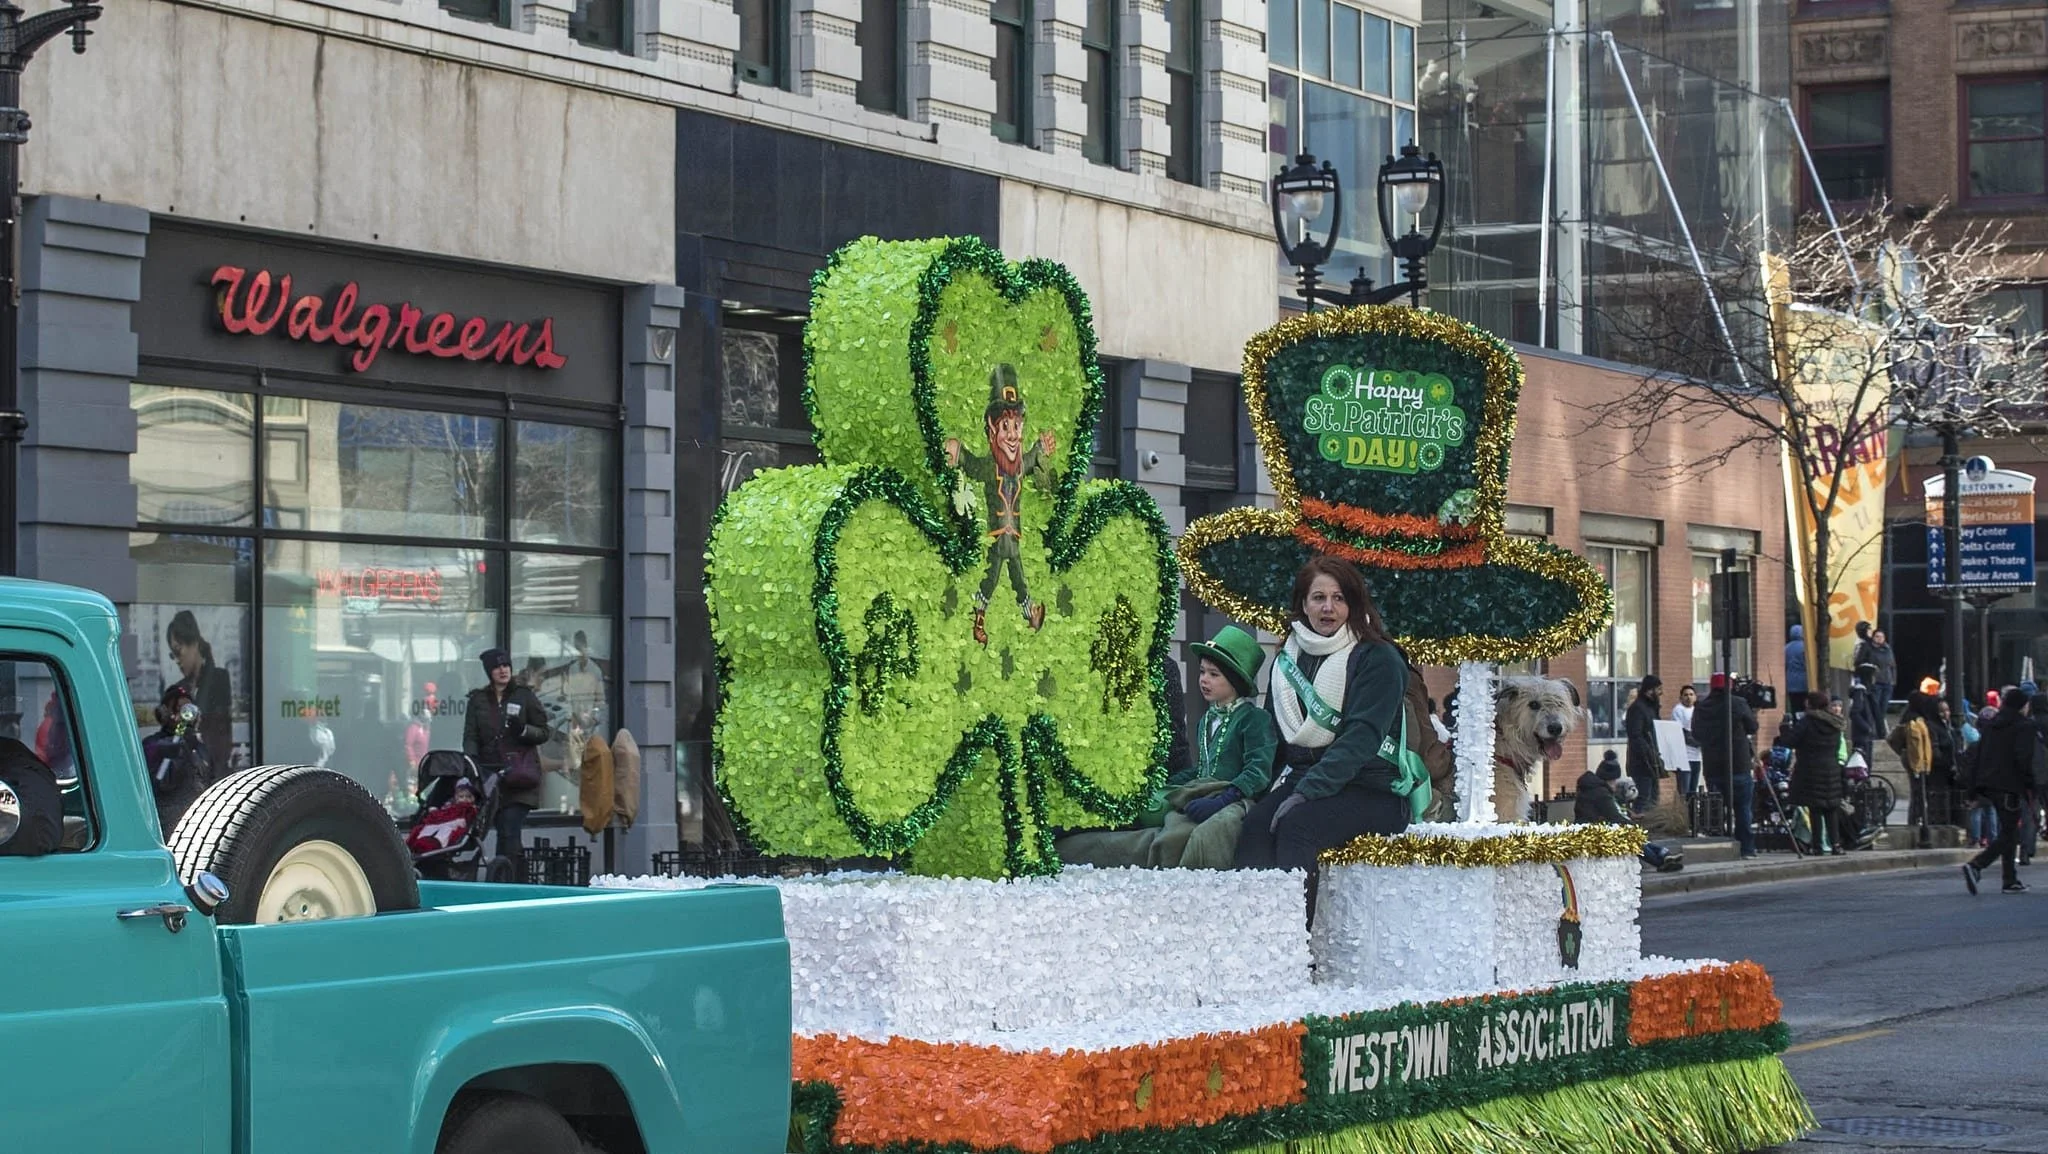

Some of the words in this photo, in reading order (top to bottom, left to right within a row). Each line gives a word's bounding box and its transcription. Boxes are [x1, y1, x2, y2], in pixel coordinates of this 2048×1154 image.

[211, 265, 568, 372] Walgreens
[1355, 371, 1423, 409] Happy
[1304, 398, 1341, 432] St.
[1342, 401, 1463, 441] Patrick's
[1346, 436, 1419, 469] DAY!
[1961, 483, 2004, 491] ESTOWN
[1976, 527, 2008, 536] Center
[1984, 541, 2016, 551] Center
[1961, 556, 1988, 566] aukee
[1989, 556, 2026, 565] Theatre
[1961, 571, 1989, 581] ellular
[1991, 571, 2019, 580] Arena
[281, 696, 342, 718] market
[1328, 1021, 1450, 1094] WESTOWN
[1477, 997, 1615, 1070] ASSOCIATION
